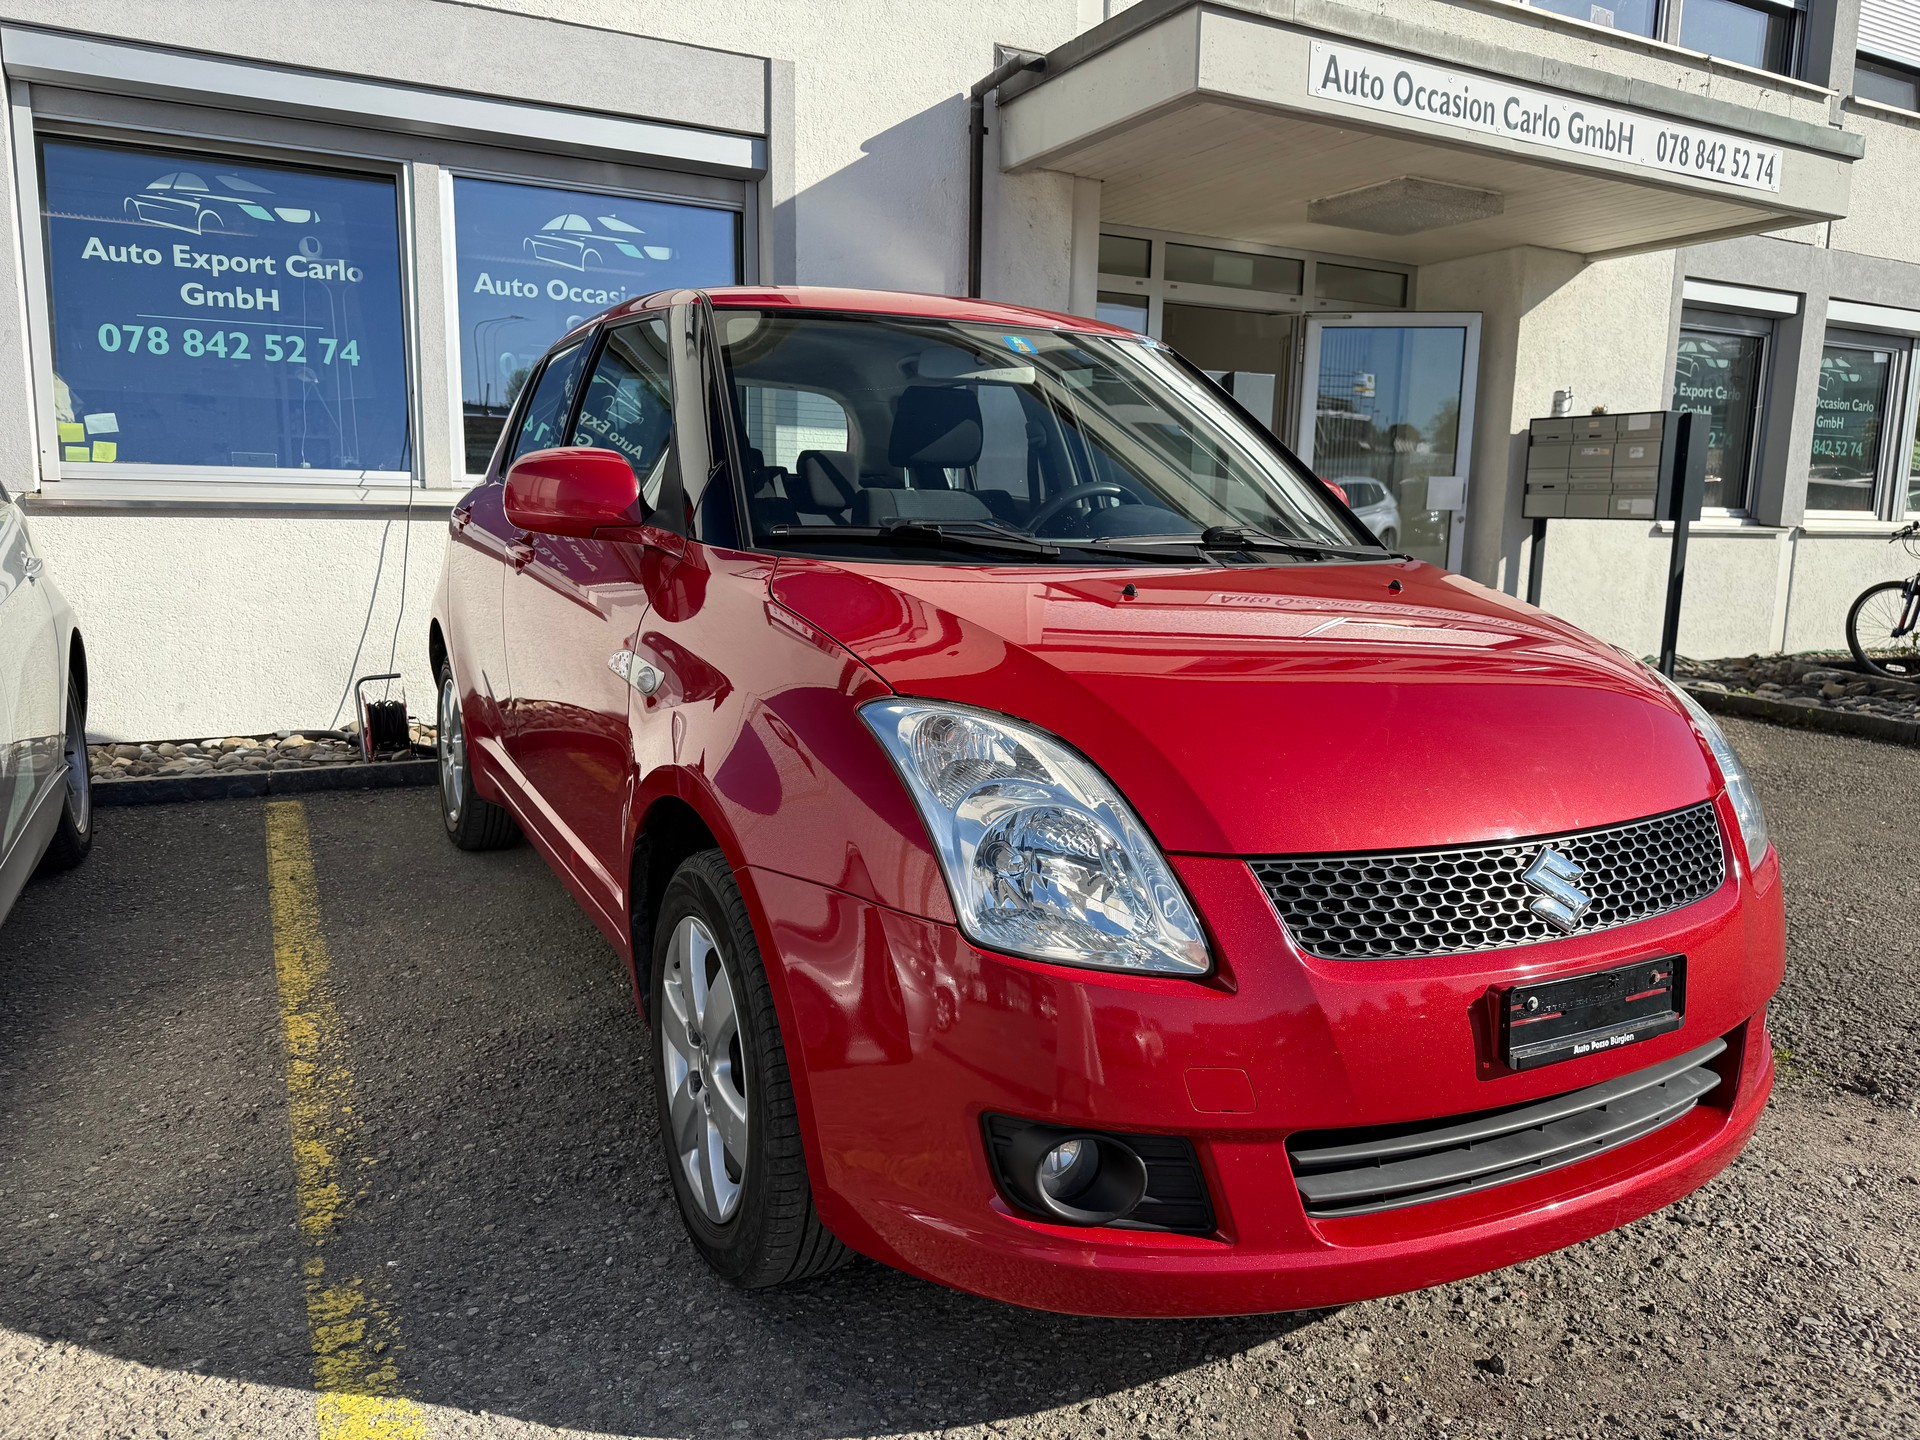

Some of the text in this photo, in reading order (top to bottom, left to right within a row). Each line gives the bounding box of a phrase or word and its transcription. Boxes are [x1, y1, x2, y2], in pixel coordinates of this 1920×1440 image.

[1321, 54, 1776, 185] Auto Occasion Carlo GmbH 078 842 52 74
[81, 237, 364, 283] Auto Export Carlo
[473, 272, 539, 298] Auto
[180, 283, 280, 311] GmbH
[98, 323, 361, 366] 078 842 52 74
[1680, 382, 1713, 400] Export
[1716, 386, 1741, 400] Carlo
[1852, 398, 1874, 412] Carlo
[1816, 415, 1844, 429] GmbH
[1813, 439, 1863, 457] 842 52 74
[1573, 1044, 1590, 1054] Auto
